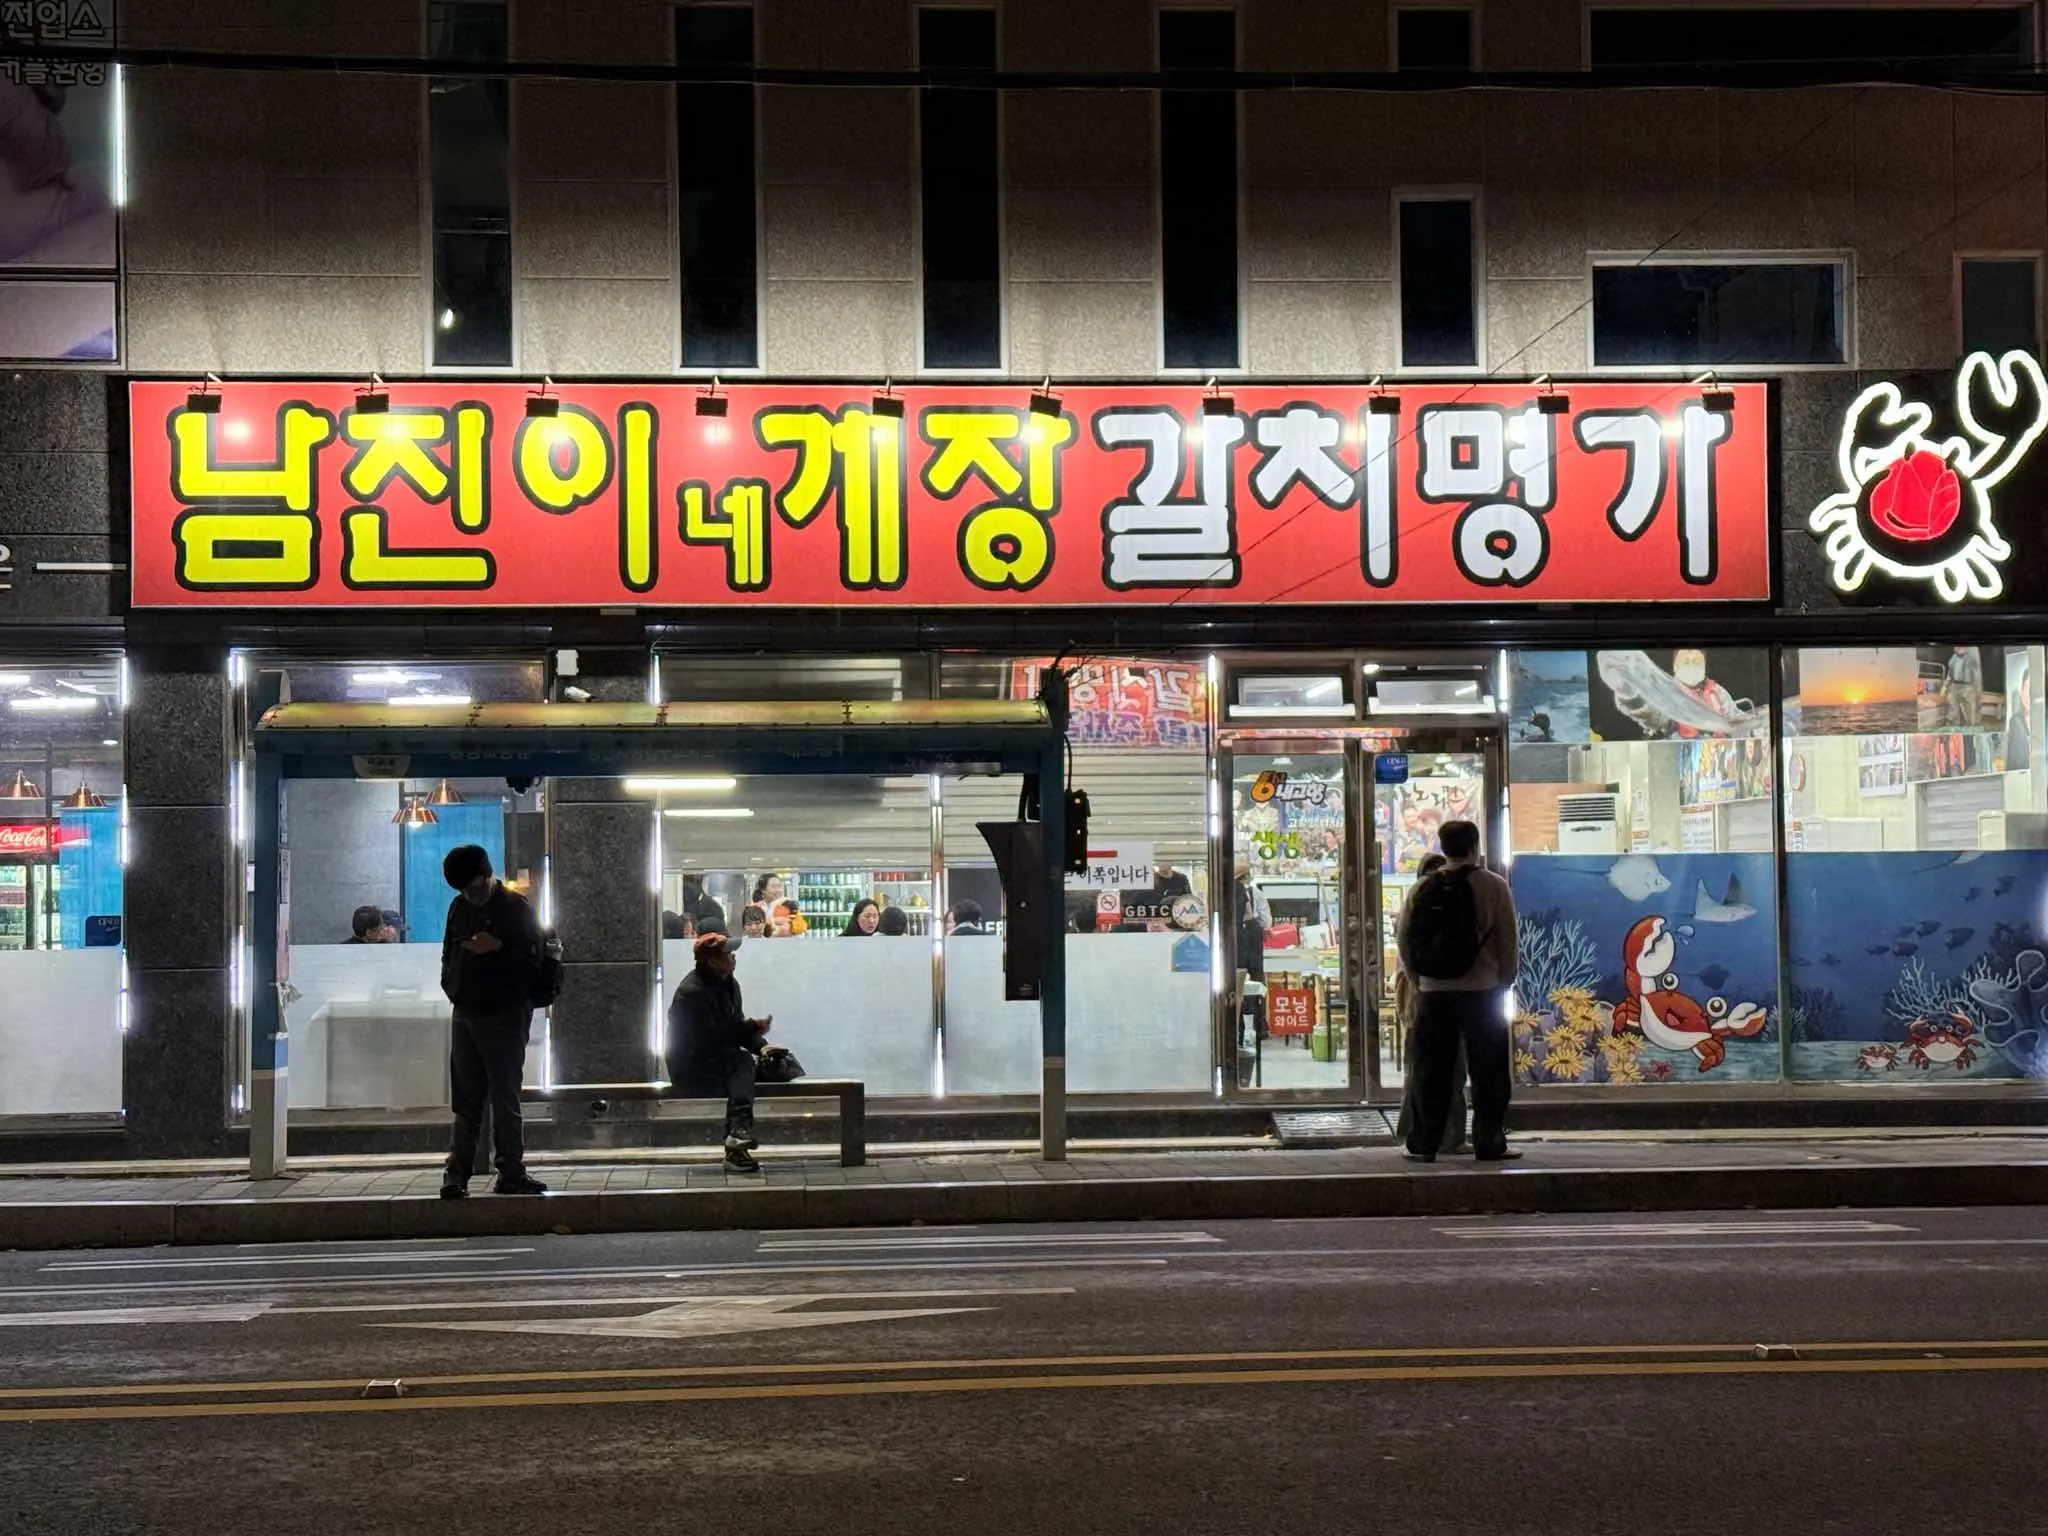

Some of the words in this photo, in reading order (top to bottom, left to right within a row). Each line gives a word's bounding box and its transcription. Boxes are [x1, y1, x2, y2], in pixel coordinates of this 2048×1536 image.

[1124, 904, 1170, 918] GBTC
[1273, 995, 1309, 1015] 모닝
[1273, 1015, 1310, 1027] 와이드
